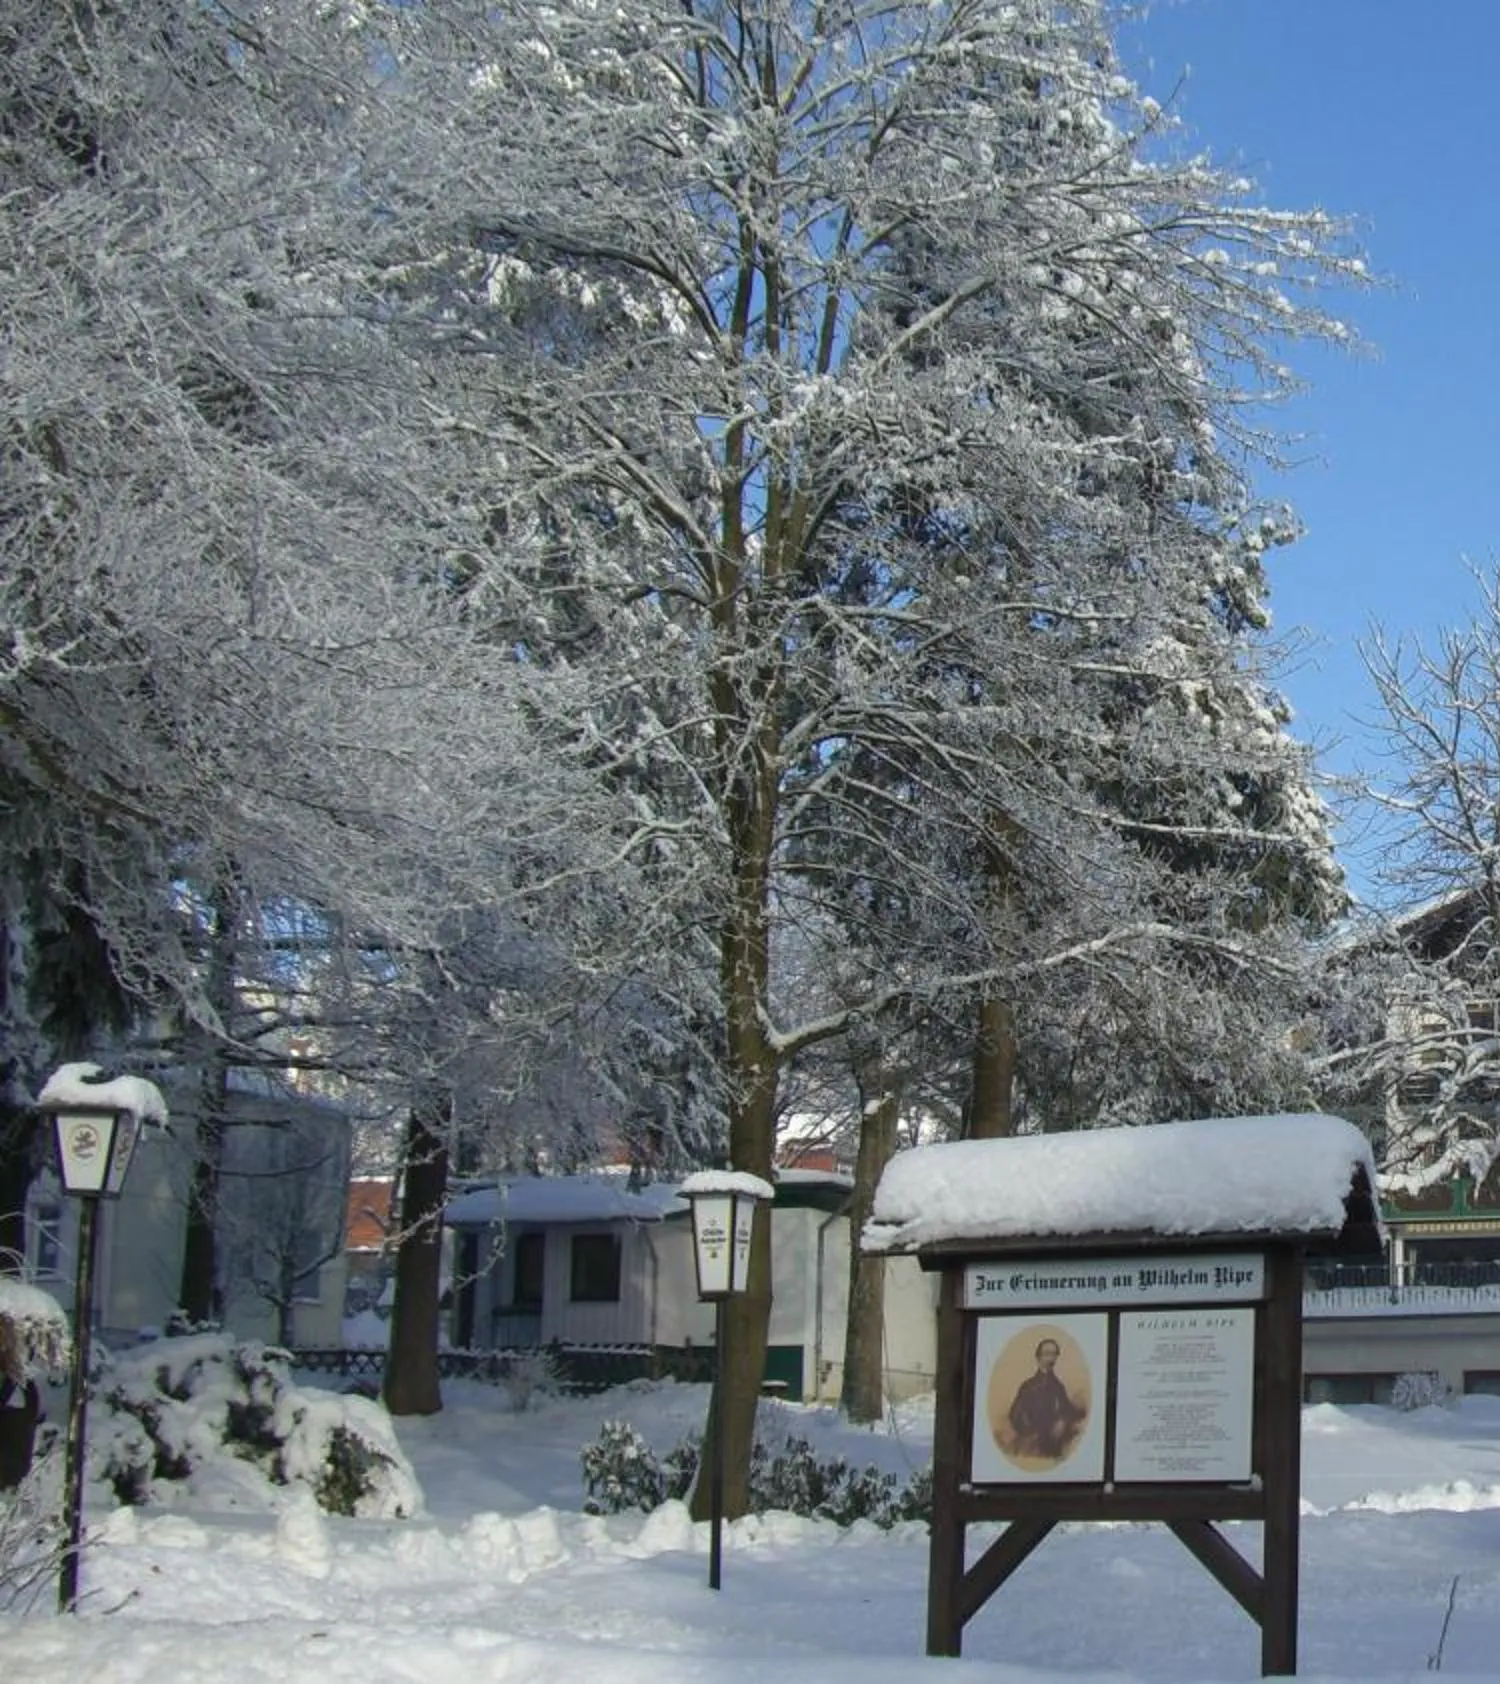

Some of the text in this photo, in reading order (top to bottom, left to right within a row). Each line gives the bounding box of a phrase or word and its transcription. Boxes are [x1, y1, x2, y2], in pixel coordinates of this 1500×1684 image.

[975, 1274, 1004, 1296] Zur
[1009, 1271, 1107, 1292] Erinnerung
[1112, 1271, 1133, 1288] an
[1137, 1266, 1209, 1291] Wilhelm
